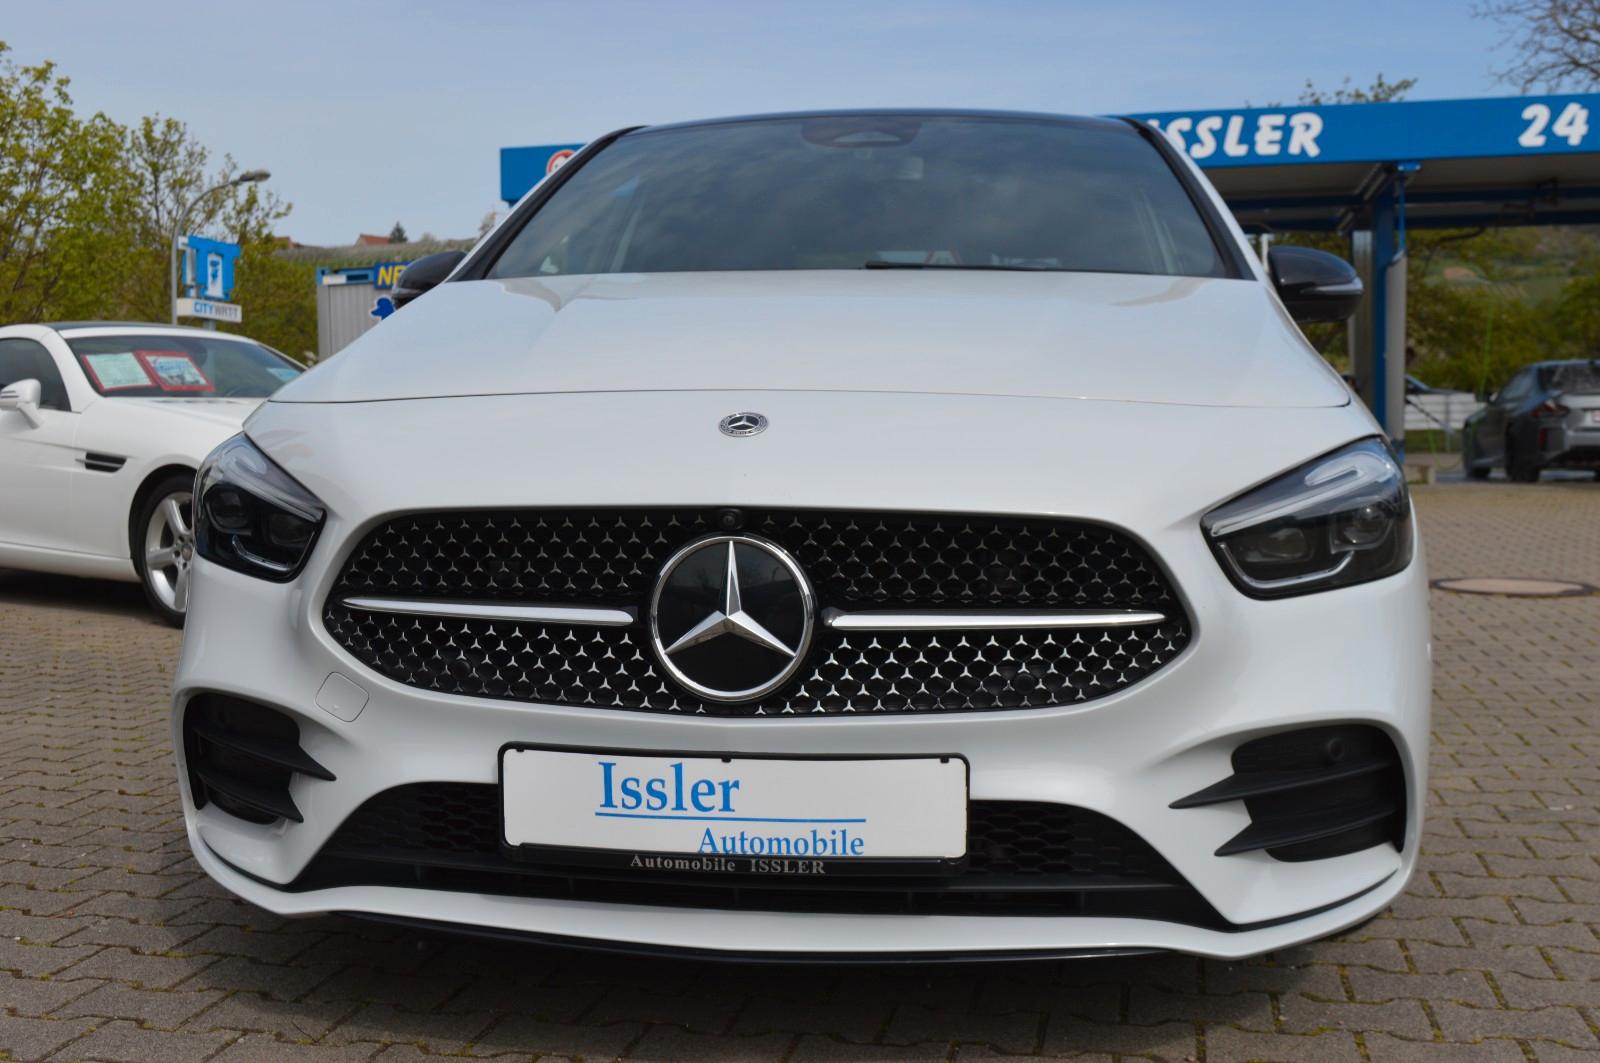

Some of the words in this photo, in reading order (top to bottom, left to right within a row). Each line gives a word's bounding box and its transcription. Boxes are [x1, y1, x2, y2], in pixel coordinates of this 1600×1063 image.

[1147, 112, 1323, 159] SSLER
[1518, 102, 1589, 147] 24
[598, 761, 740, 812] Issler
[697, 827, 864, 855] Automobile
[630, 854, 736, 872] Automobile
[751, 859, 825, 874] ISSLER
